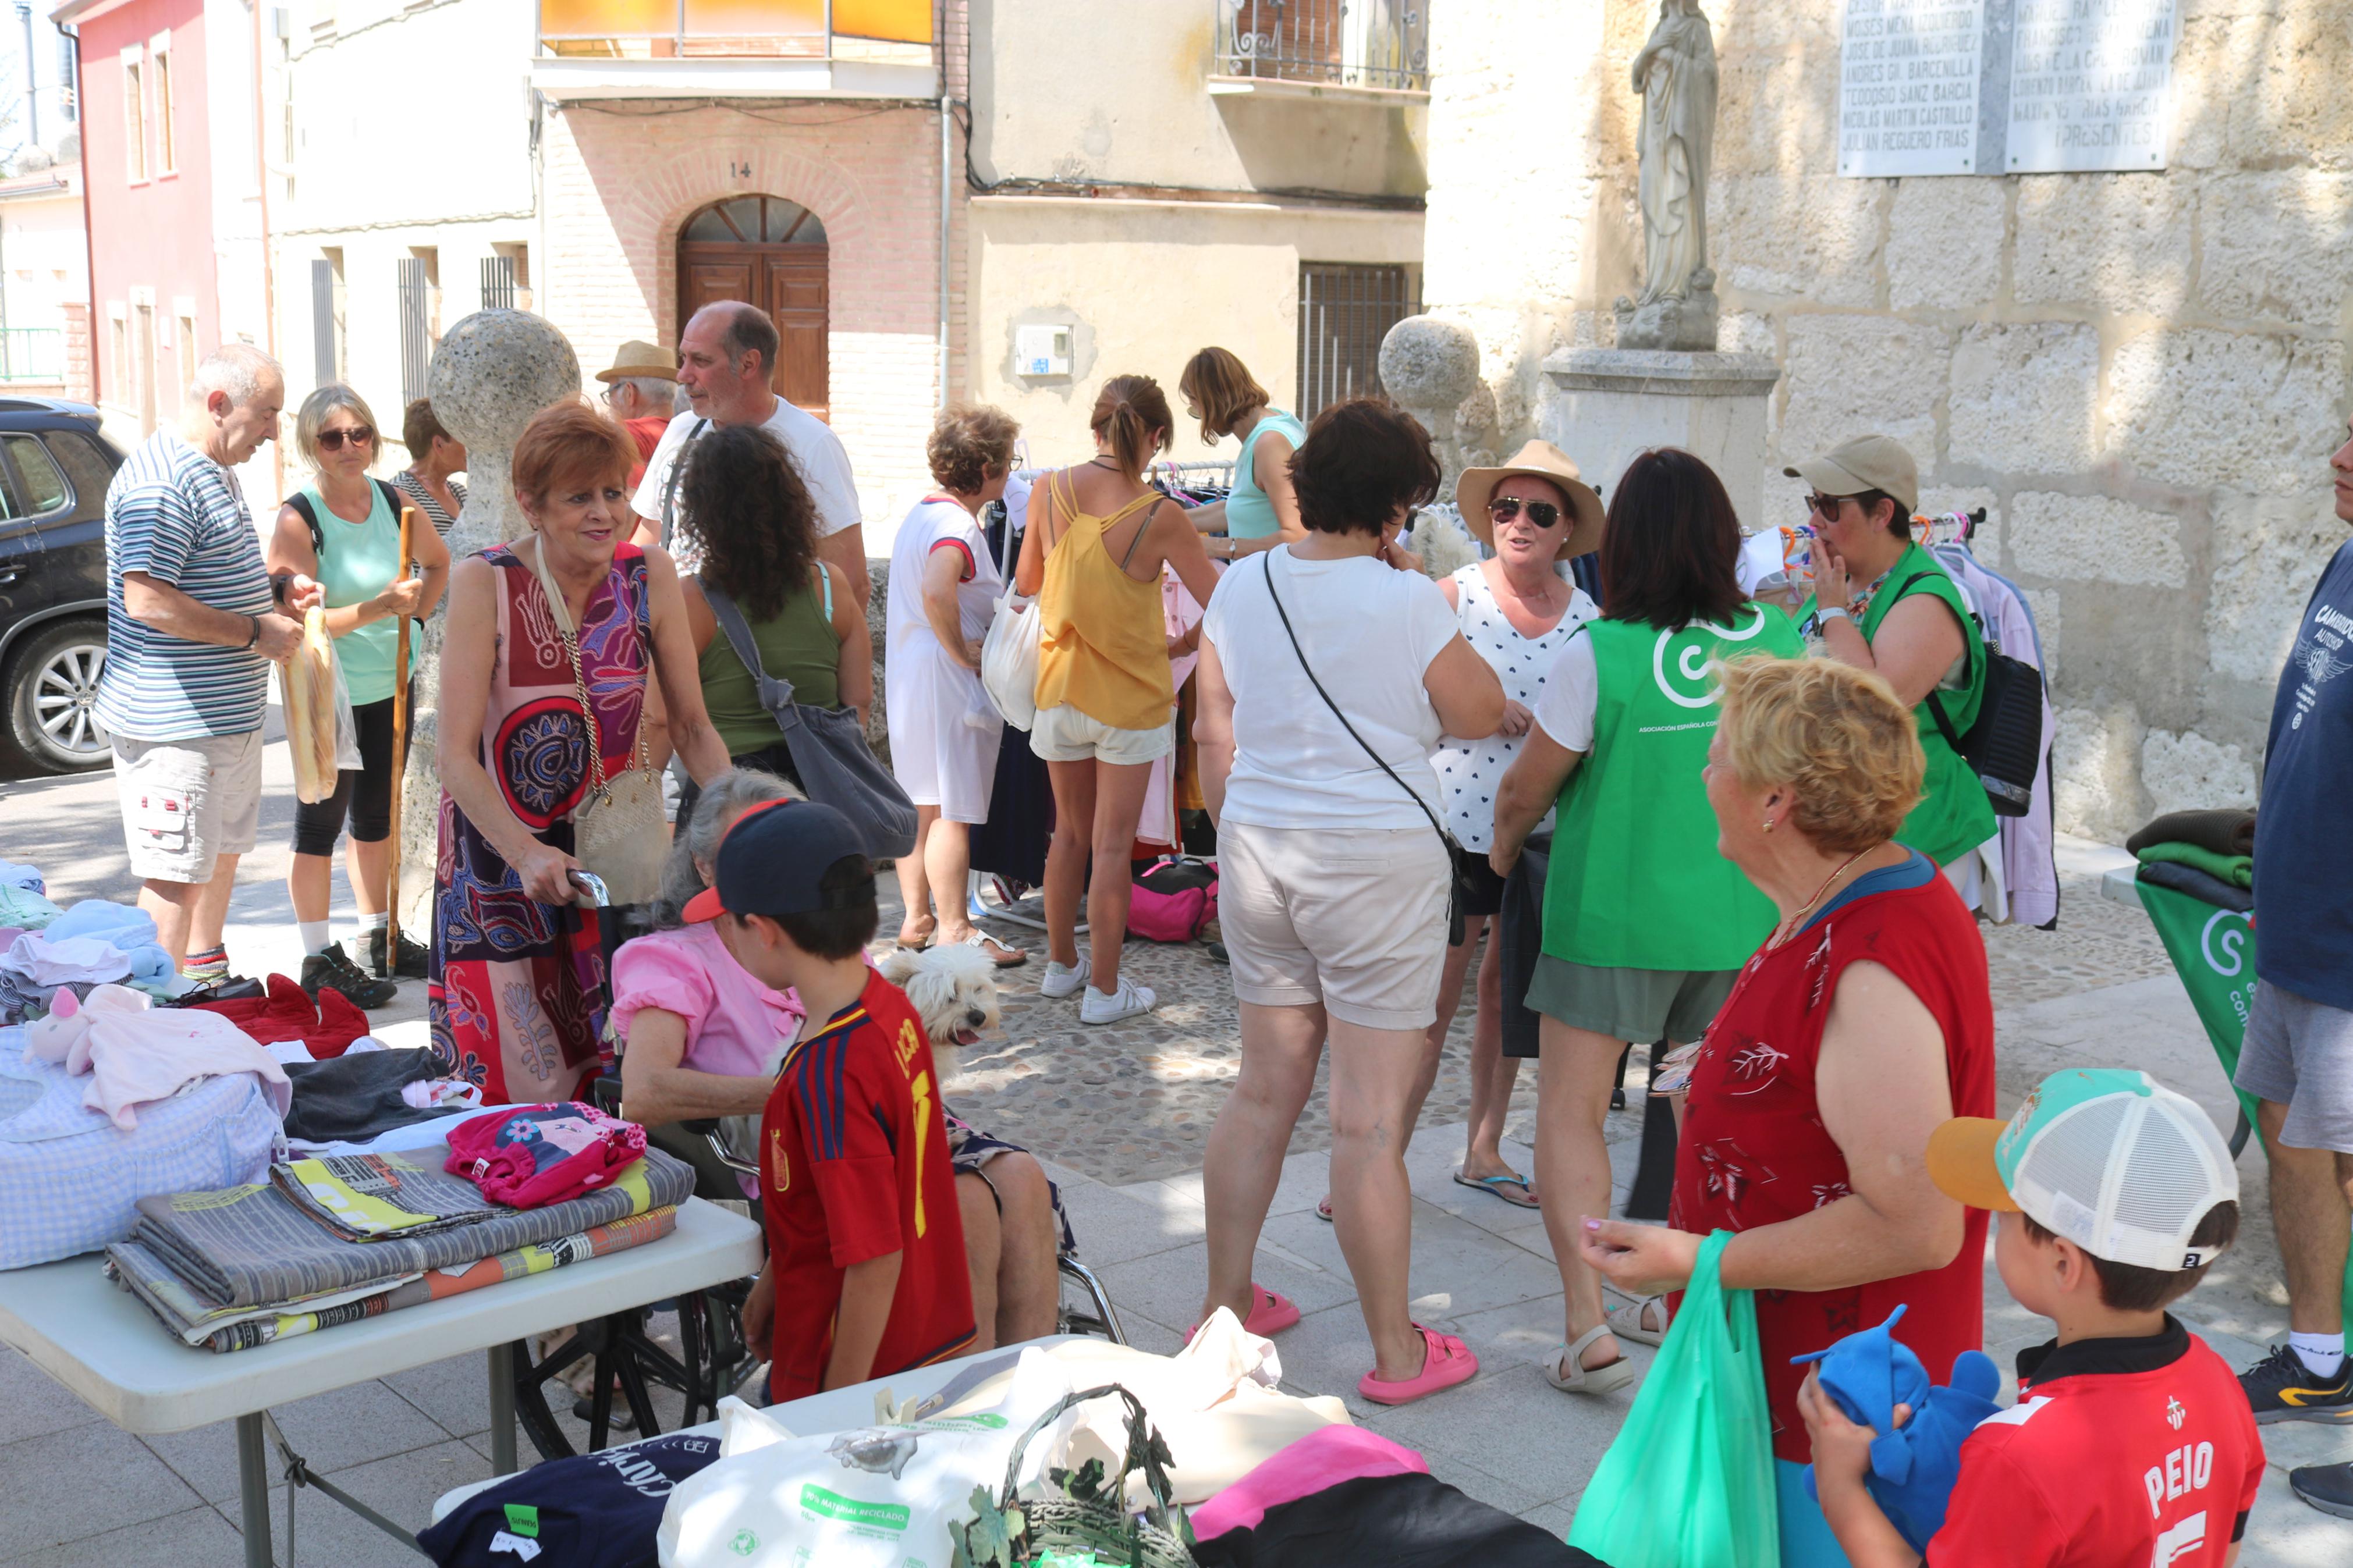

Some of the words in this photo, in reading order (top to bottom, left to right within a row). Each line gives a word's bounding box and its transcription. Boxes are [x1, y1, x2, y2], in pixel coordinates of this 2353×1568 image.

[1847, 18, 1883, 37] MOISES
[1887, 16, 1914, 34] MENA
[2016, 27, 2081, 49] FRANCISCO
[1846, 42, 1869, 61] JOSE
[1873, 41, 1885, 59] DE
[1889, 38, 1919, 57] JUANA
[2065, 51, 2080, 70] LA
[1846, 64, 1883, 83] ANDRES
[1888, 63, 1903, 81] GIL
[1908, 59, 1973, 80] BARCENILLA
[1846, 87, 1896, 106] TEODOSIO
[1900, 84, 1929, 103] SANZ
[1933, 82, 1971, 101] GARCIA
[2013, 77, 2053, 97] LORENZO
[2057, 74, 2113, 95] BARCENLA
[2117, 73, 2130, 91] DE
[1843, 111, 1879, 129] NICOLAS
[1883, 109, 1917, 127] MARTIN
[1920, 106, 1972, 125] CASTRILLO
[1843, 132, 1879, 151] JULIAN
[1882, 131, 1932, 150] REGUERO
[1936, 130, 1968, 148] FRIAS
[730, 162, 751, 178] 14
[1638, 725, 1676, 733] ASOCIACIÓN
[1677, 721, 1705, 731] ESPAÑOLA
[2144, 1441, 2214, 1520] PEIO
[821, 1498, 857, 1516] MATERIAL
[859, 1509, 904, 1522] RECICLADO
